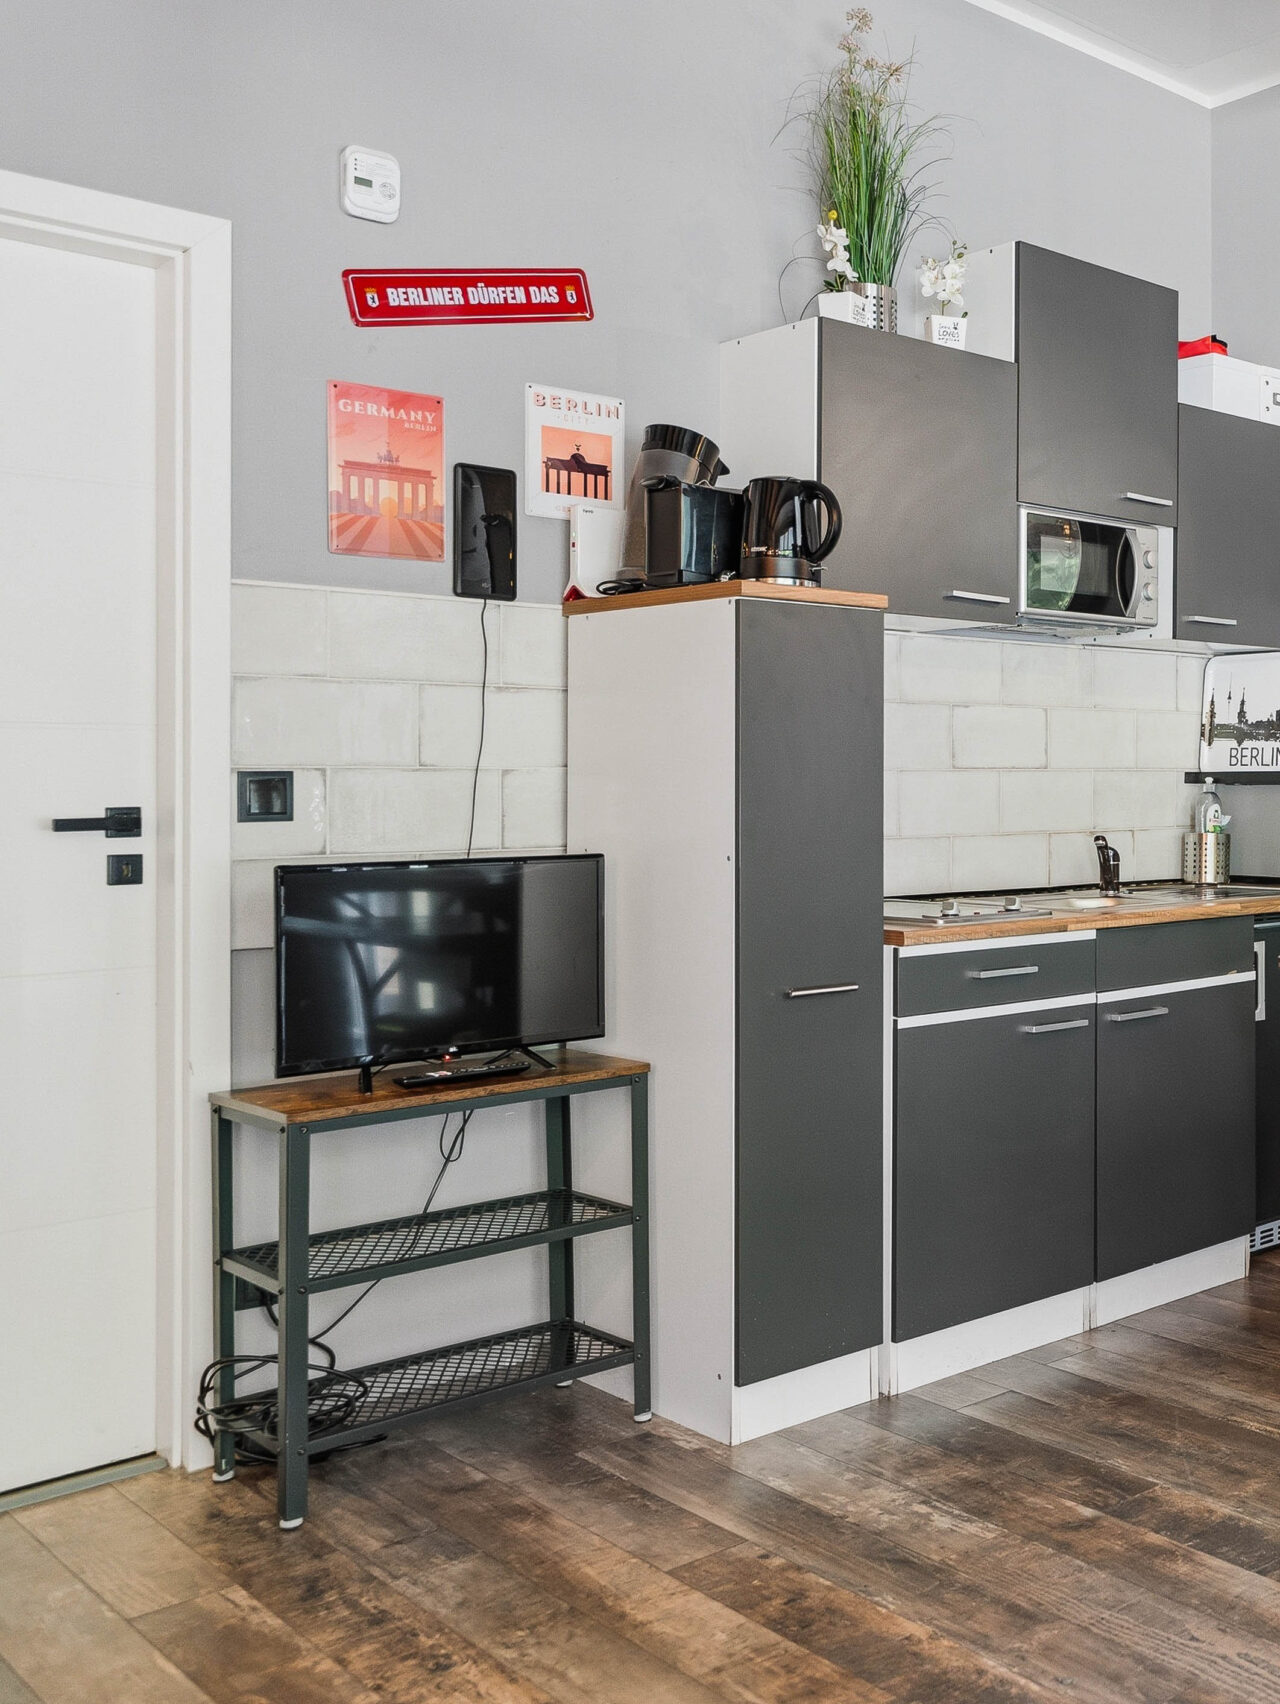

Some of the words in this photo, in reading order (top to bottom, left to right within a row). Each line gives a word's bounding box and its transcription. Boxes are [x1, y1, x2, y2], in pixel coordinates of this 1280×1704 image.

[386, 287, 465, 306] BERLINER
[467, 282, 527, 305] DÜRFEN
[528, 285, 559, 304] DAS
[338, 399, 436, 424] GERMANY
[533, 392, 620, 419] BERLIN
[404, 421, 437, 432] BERLIN
